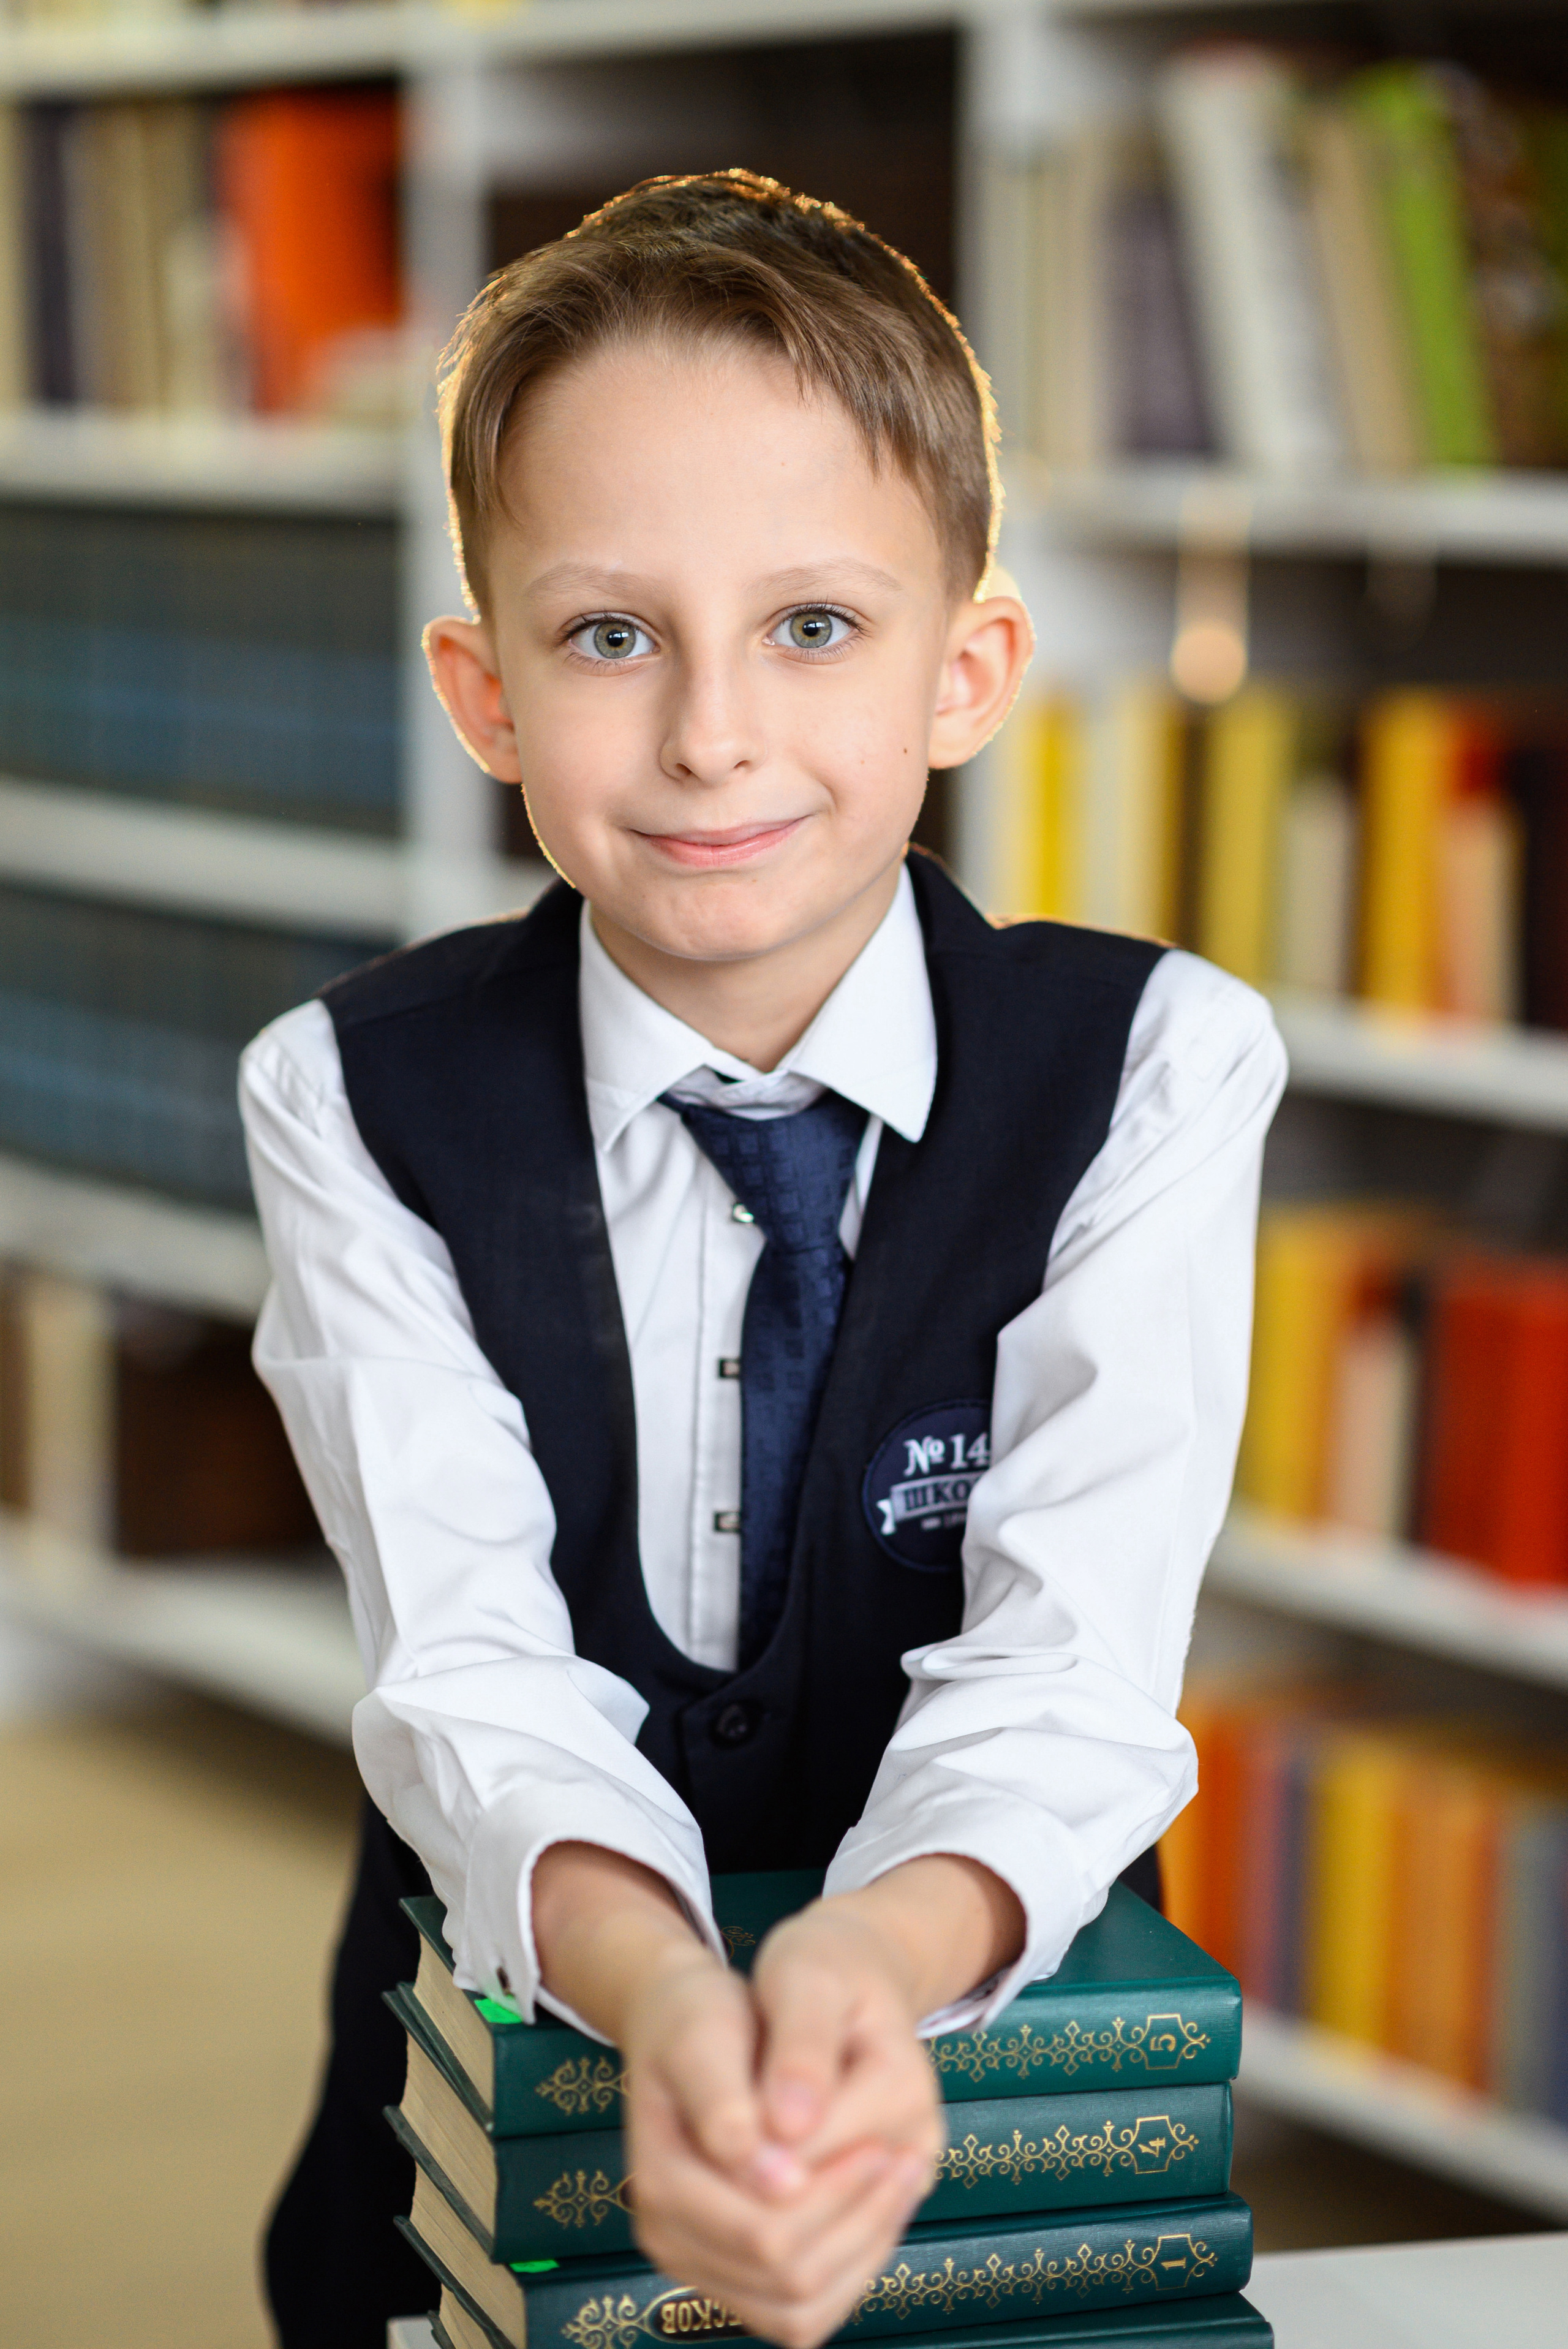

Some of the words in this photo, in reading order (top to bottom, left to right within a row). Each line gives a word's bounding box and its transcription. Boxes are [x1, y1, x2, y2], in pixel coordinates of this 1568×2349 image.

[905, 1480, 971, 1511] ШКО
[1150, 2033, 1176, 2052] 5
[1138, 2137, 1166, 2158] 4
[1161, 2256, 1186, 2271] 1
